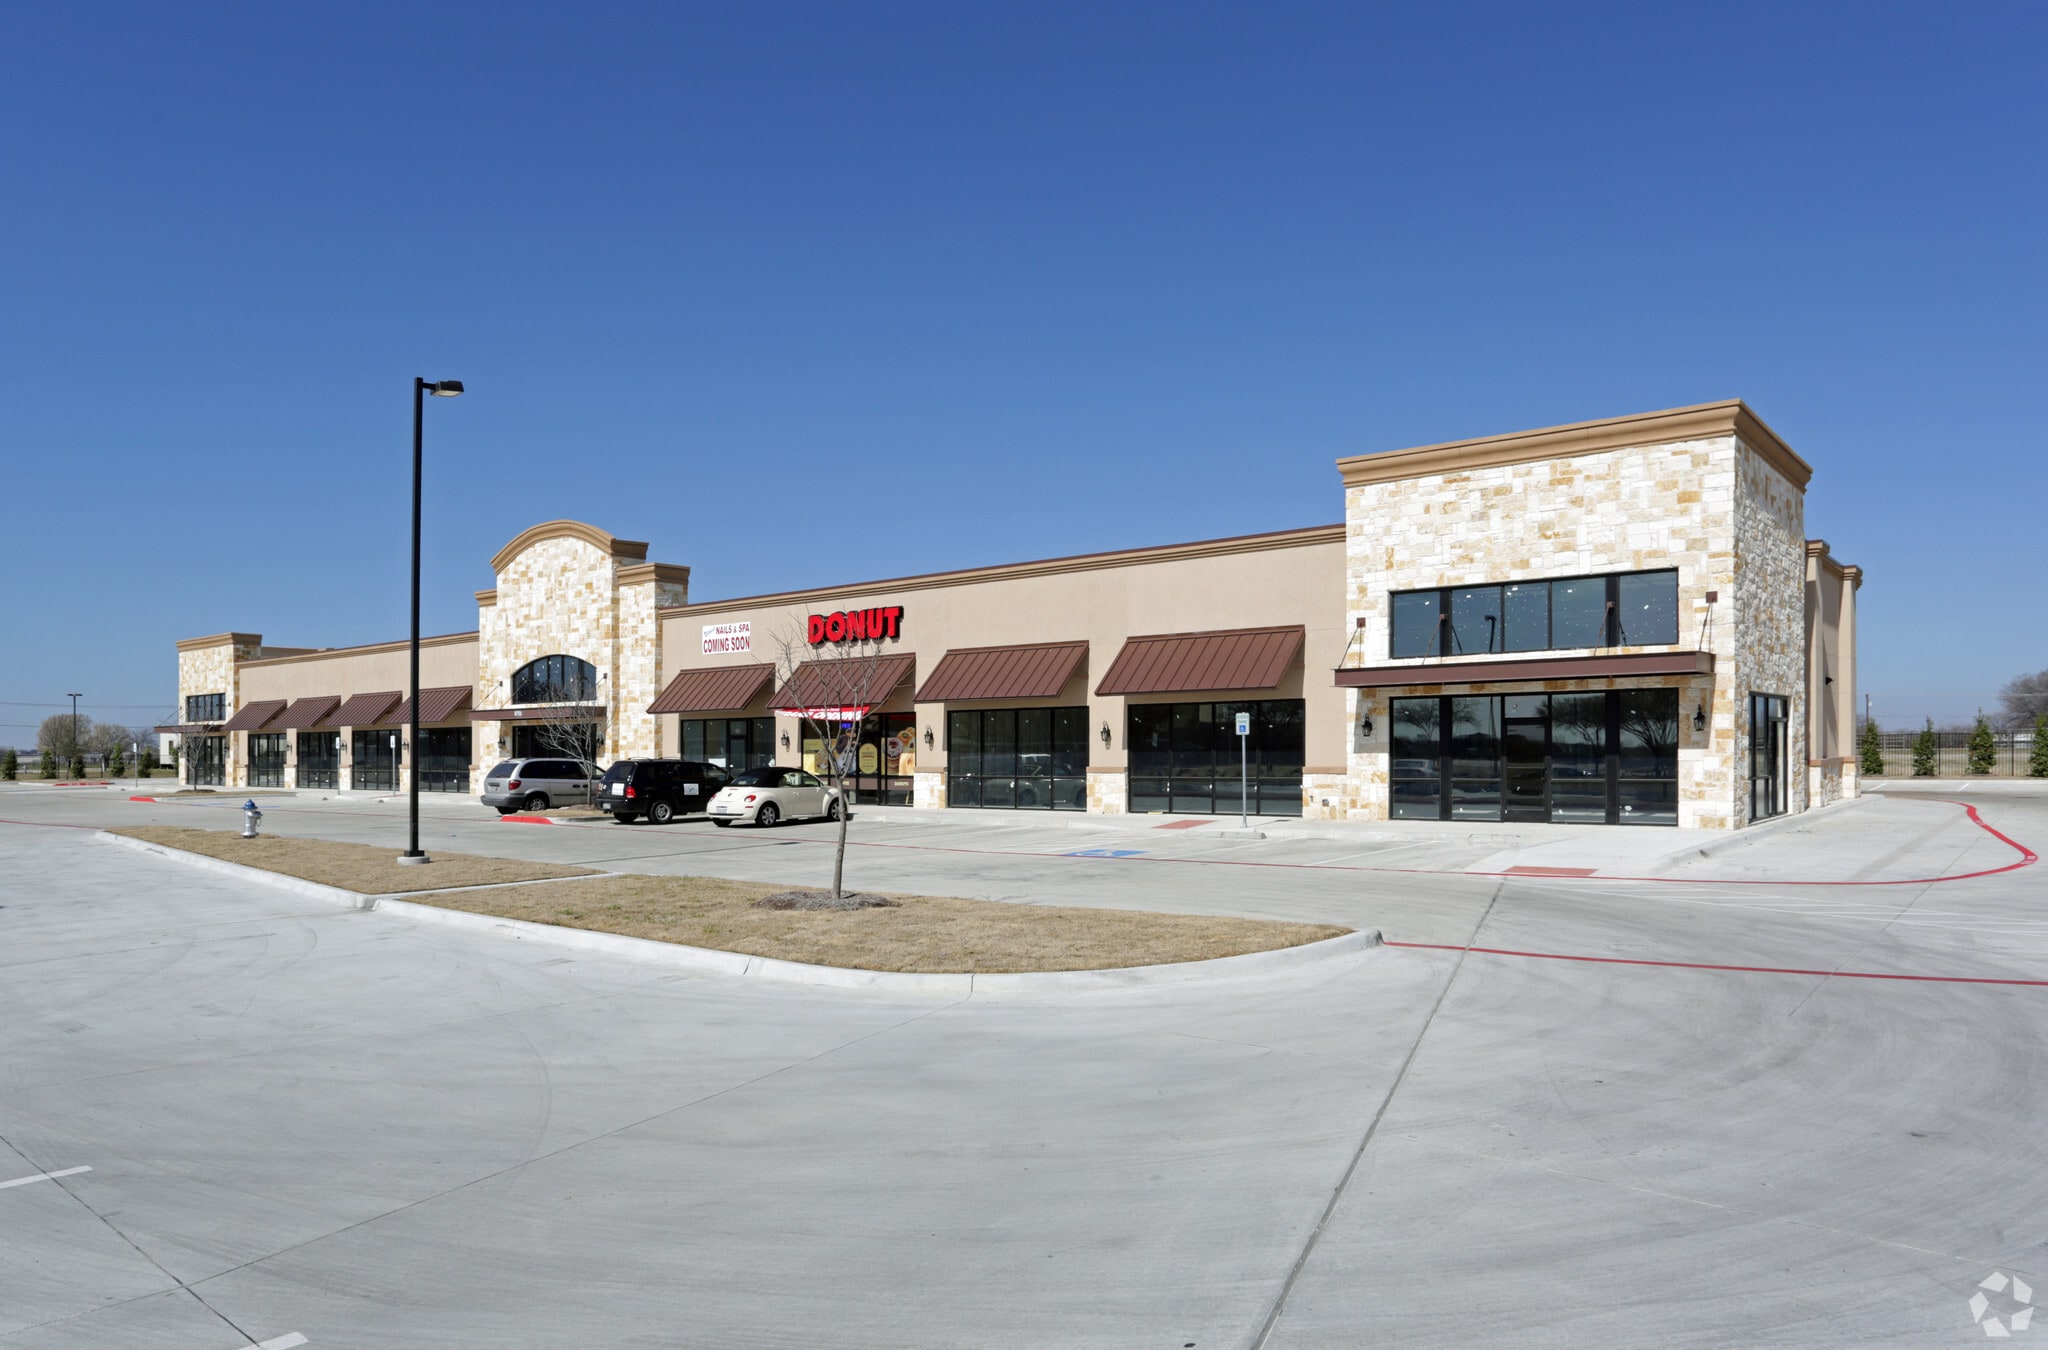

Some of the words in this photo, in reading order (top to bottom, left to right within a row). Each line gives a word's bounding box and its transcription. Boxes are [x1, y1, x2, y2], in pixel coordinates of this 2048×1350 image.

[716, 625, 732, 634] NAILS
[738, 623, 750, 632] SPA
[808, 606, 903, 644] DONUT
[703, 638, 730, 653] COMING
[731, 636, 750, 651] SOON
